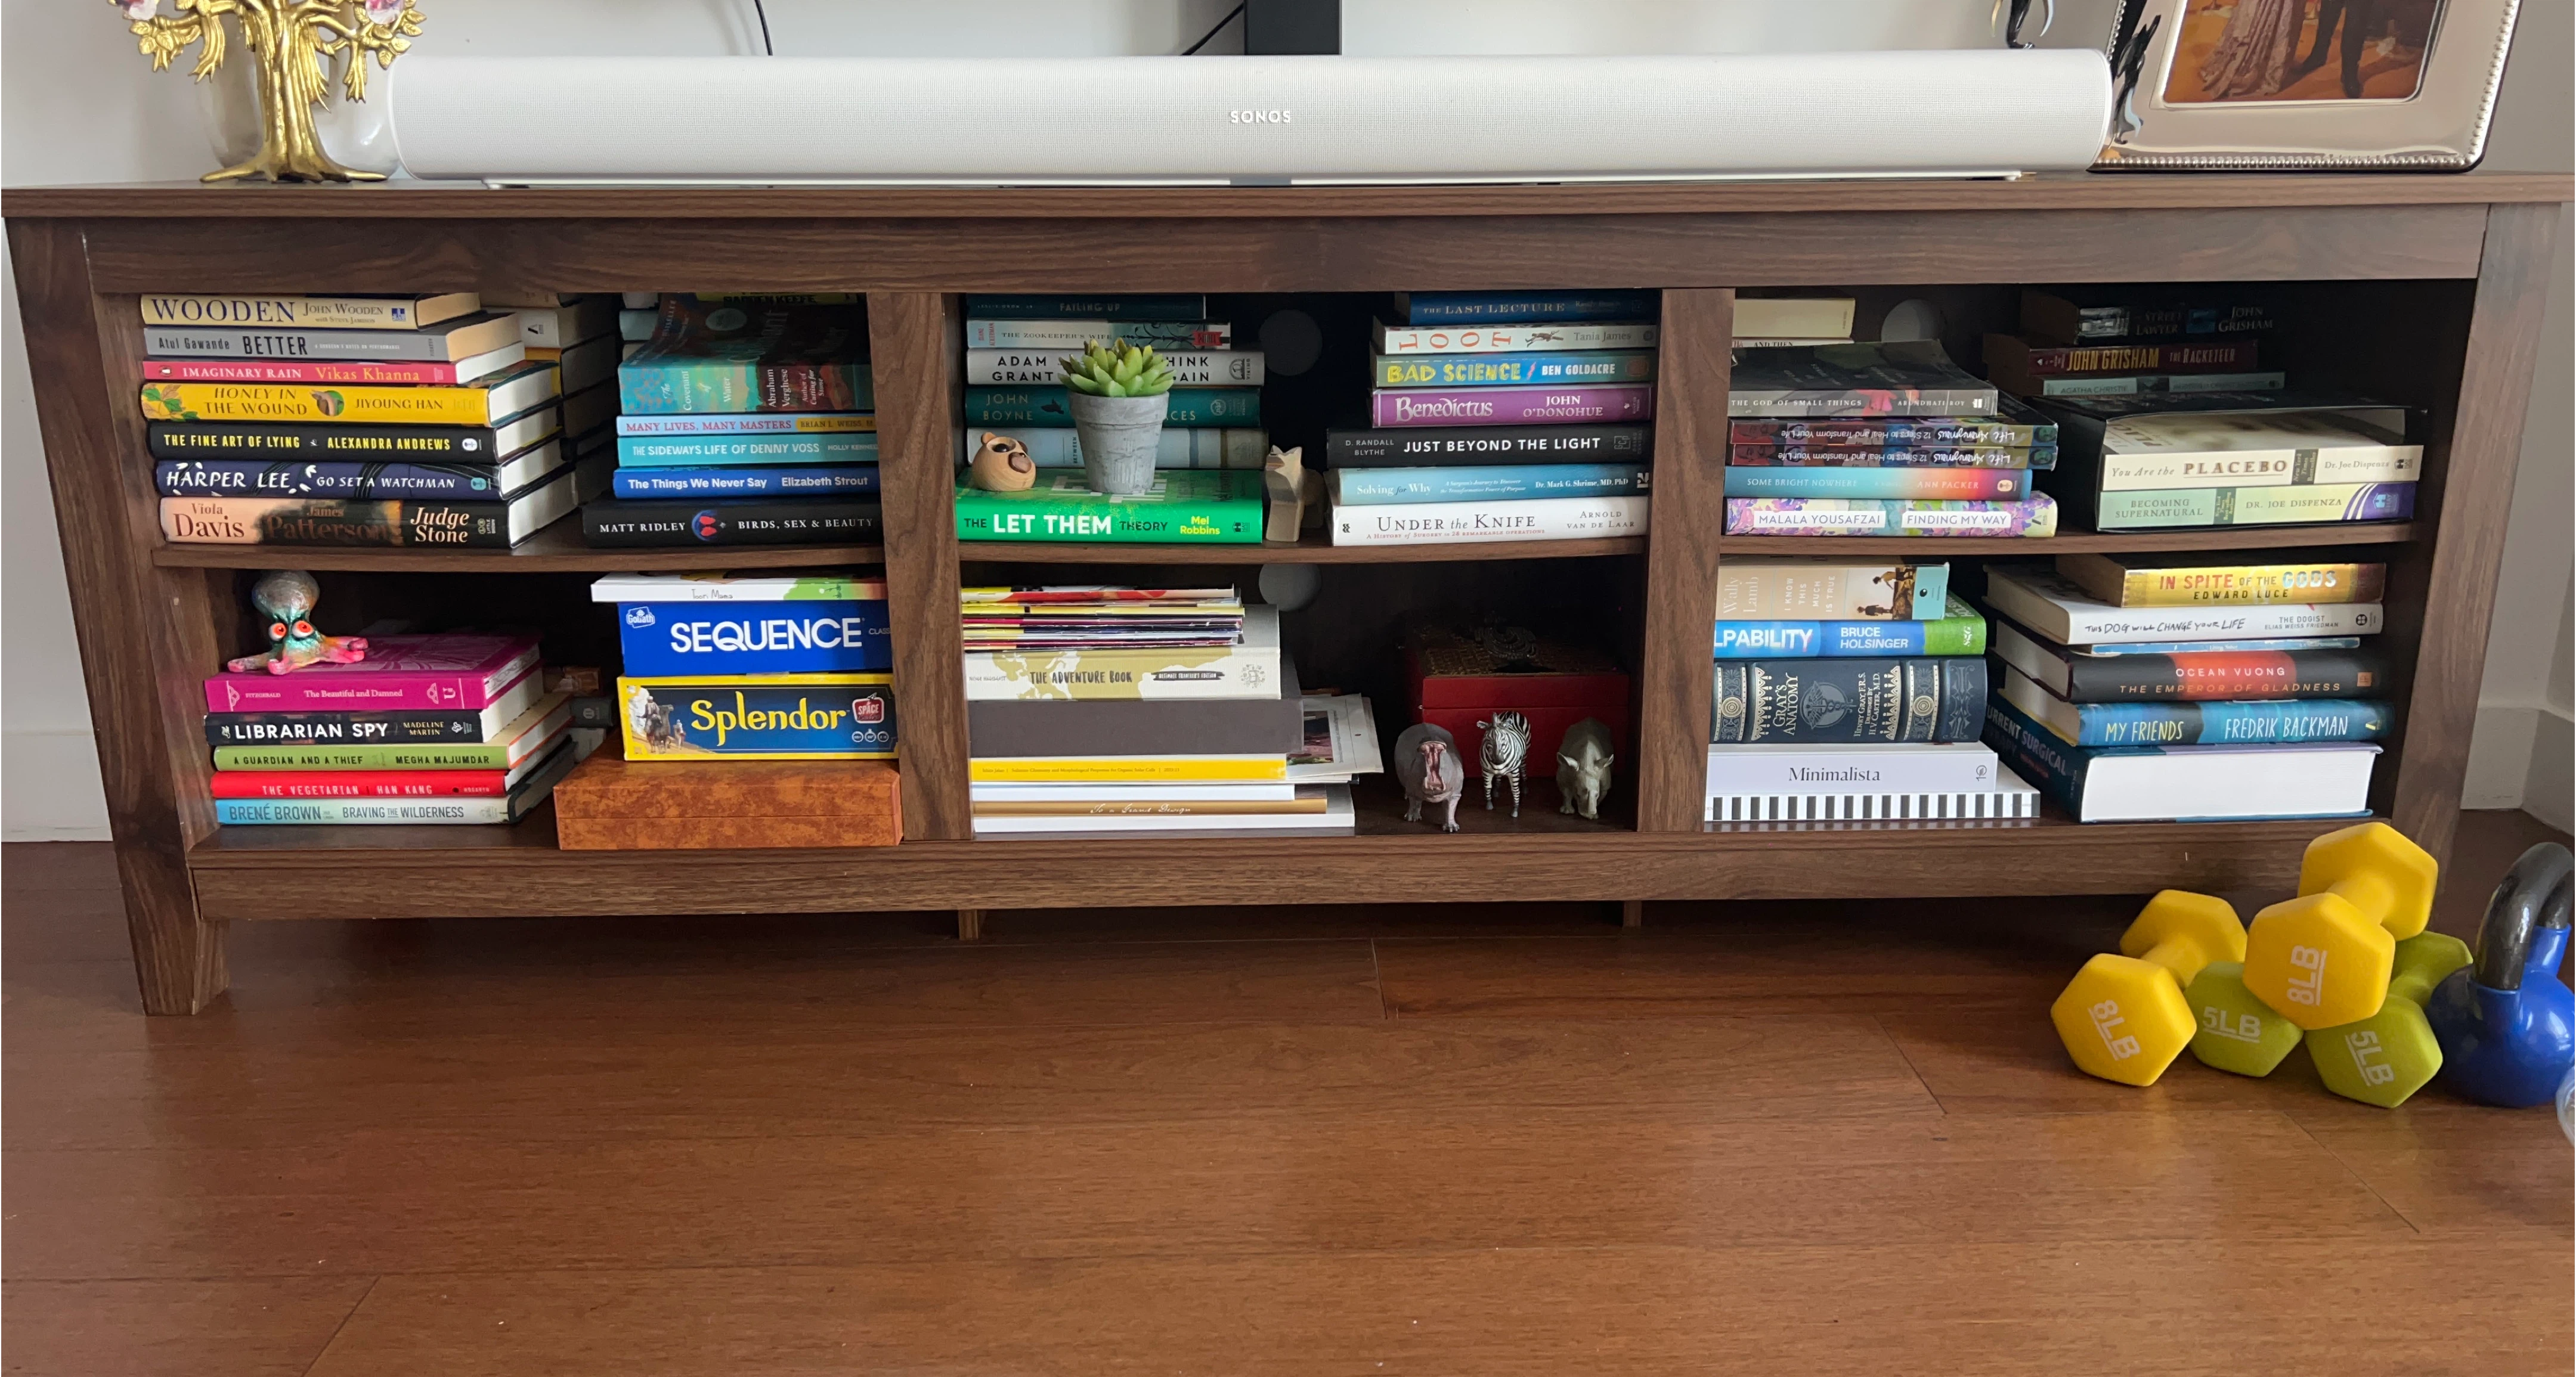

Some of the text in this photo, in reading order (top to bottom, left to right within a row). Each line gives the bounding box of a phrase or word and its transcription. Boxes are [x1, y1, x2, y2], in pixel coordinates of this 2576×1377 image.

[1230, 110, 1291, 123] SONOS
[151, 299, 295, 322] WOODEN
[303, 303, 383, 316] JOHN WOODEN
[1574, 331, 1631, 341] Tania James
[159, 337, 230, 349] Atul Gawande
[243, 336, 308, 355] BETTER
[998, 356, 1046, 366] ADAM
[2067, 348, 2159, 371] JOHN GRISHAM
[183, 367, 301, 378] IMAGINARY RAIN
[315, 367, 357, 380] Vikas
[363, 368, 420, 381] Khanna
[992, 372, 1053, 380] GRANT
[1387, 363, 1521, 382] BAD SCIENCE
[1542, 364, 1615, 375] BEN GOLDACRE
[215, 387, 296, 399] HONEY IN
[986, 394, 1028, 405] JOHN
[355, 399, 411, 409] JIYOUNG
[416, 399, 443, 409] HAN
[1546, 396, 1581, 407] JOHN
[205, 402, 307, 415] THE WOUND
[1395, 396, 1493, 422] Benedictus
[1524, 407, 1603, 418] O'DONOHUE
[983, 411, 1033, 421] BOYNE
[664, 422, 698, 431] LIVES,
[740, 420, 791, 429] MASTERS
[165, 435, 300, 448] THE FINE ART OF LYING
[328, 437, 450, 450] ALEXANDRA ANDREWS
[1404, 438, 1600, 452] JUST BEYOND THE LIGHT
[633, 444, 819, 455] THE SIDEWAYS LIFE OF DENNY VOSS
[2112, 460, 2287, 477] You Are the PLACEBO
[166, 472, 290, 488] HARPER LEE
[628, 478, 767, 489] The Things We Never Say
[782, 477, 868, 486] Elizabeth Strout
[192, 503, 223, 514] Viola
[2131, 499, 2190, 507] BECOMING
[410, 507, 470, 528] Judge
[2115, 508, 2203, 517] SUPERNATURAL
[174, 513, 244, 538] Davis
[964, 514, 1168, 534] THE LET THEM THEORY
[1191, 516, 1209, 525] Mel
[1377, 514, 1535, 531] UNDER the KNIFE
[1759, 515, 1880, 524] MALALA YOUSAFZAI
[1908, 516, 2007, 524] FINDING MY WAY
[416, 525, 468, 542] Stone
[599, 522, 686, 532] MATT RIDLEY
[1180, 525, 1220, 535] Robbins
[2160, 576, 2176, 589] IN
[2184, 574, 2233, 588] SPITE
[2283, 570, 2336, 588] GODS
[2194, 590, 2288, 600] EDWARD LUCE
[628, 615, 654, 624] Goliath
[671, 618, 862, 652] SEQUENCE
[1841, 627, 1880, 637] BRUCE
[1840, 639, 1908, 649] HOLSINGER
[1030, 671, 1132, 684] THE ADVENTURE BOOK
[2236, 668, 2285, 676] VUONG
[858, 704, 879, 715] SPACE
[1773, 684, 1787, 727] GRAY'S
[1785, 672, 1798, 735] ANATOMY
[691, 691, 847, 746] Splendor
[234, 724, 388, 739] LIBRARIAN SPY
[2105, 721, 2184, 741] MY FRIENDS
[2225, 716, 2348, 739] FREDRIK BACKMAN
[1789, 767, 1880, 781] Minimalista
[262, 786, 359, 796] THE VEGETARIAN
[405, 785, 432, 794] KANG
[230, 804, 271, 820] BRENÉ
[274, 807, 321, 820] BROWN
[343, 807, 385, 818] BRAVING
[401, 807, 464, 818] WILDERNESS
[2287, 945, 2321, 1006] 8LB
[2092, 999, 2140, 1060] 8LB
[2203, 1007, 2261, 1039] 5LB
[2350, 1031, 2394, 1085] 5LB
